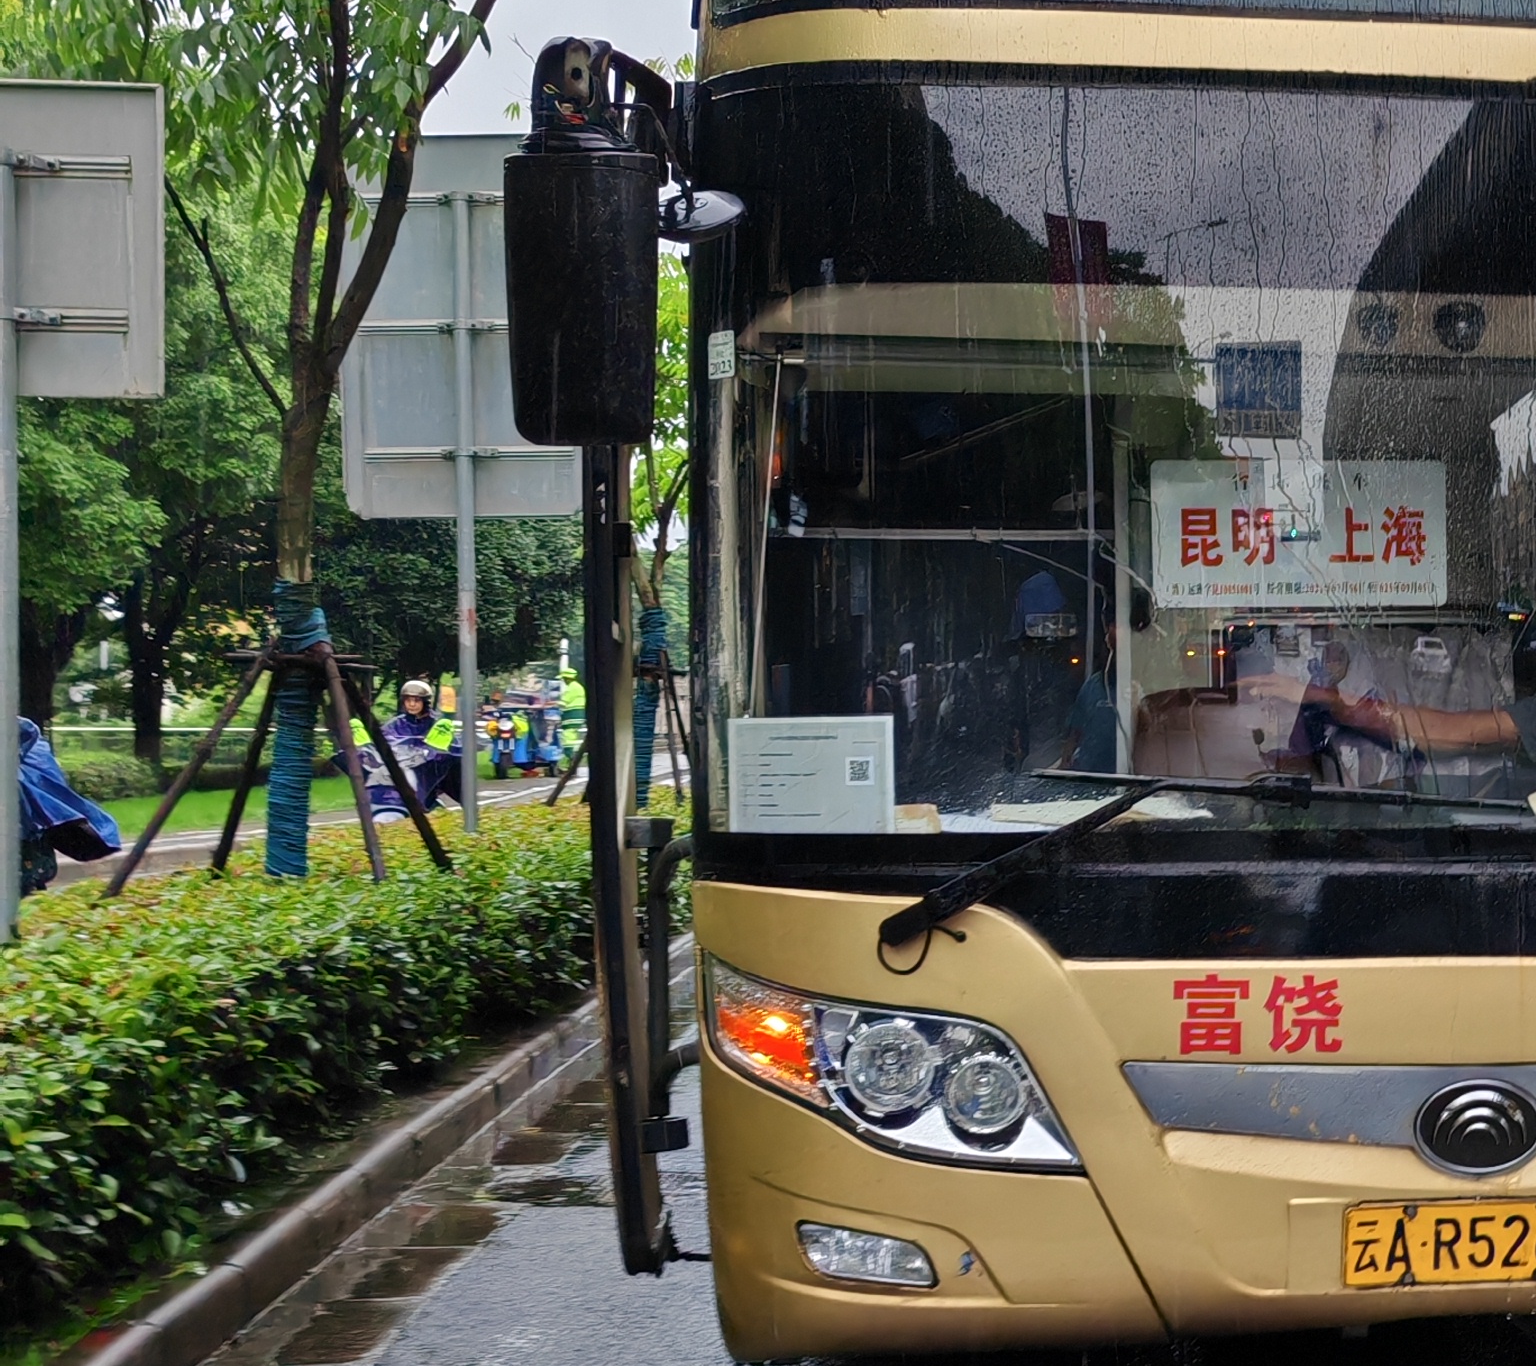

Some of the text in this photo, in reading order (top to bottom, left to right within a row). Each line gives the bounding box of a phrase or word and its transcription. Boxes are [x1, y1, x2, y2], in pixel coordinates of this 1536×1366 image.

[1181, 505, 1427, 567] 昆明 上海
[1173, 974, 1344, 1055] 富饶
